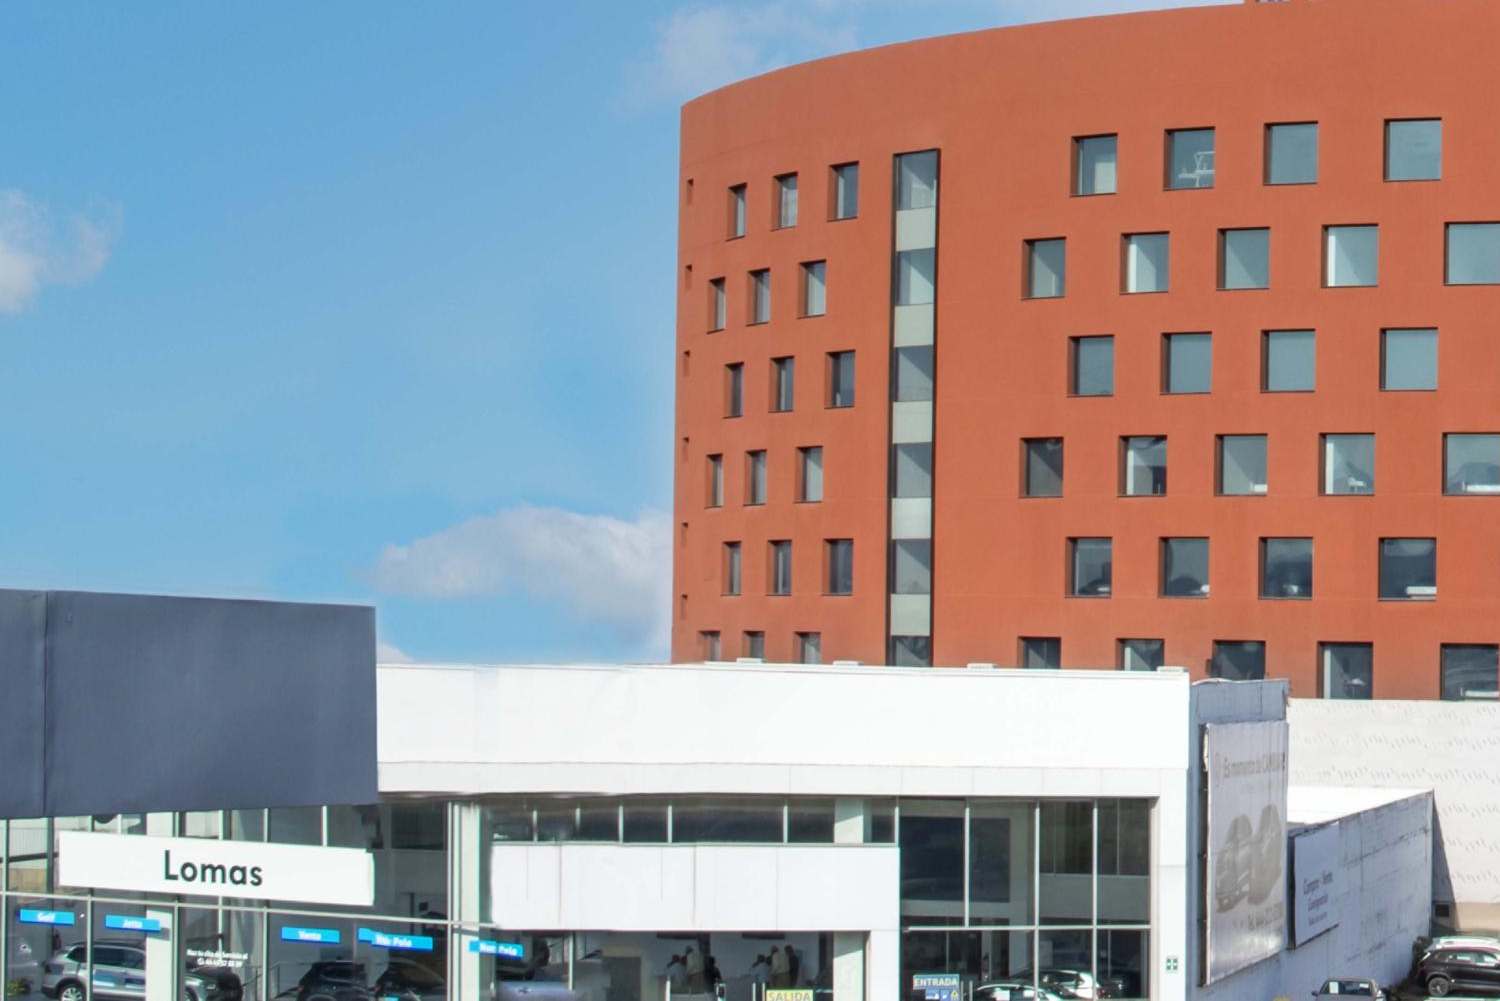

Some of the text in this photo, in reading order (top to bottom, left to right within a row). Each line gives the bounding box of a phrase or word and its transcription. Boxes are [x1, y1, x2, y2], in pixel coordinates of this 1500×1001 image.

[164, 849, 263, 887] Lomas
[914, 977, 959, 987] ENTRADA
[767, 991, 811, 1001] SALIDA
